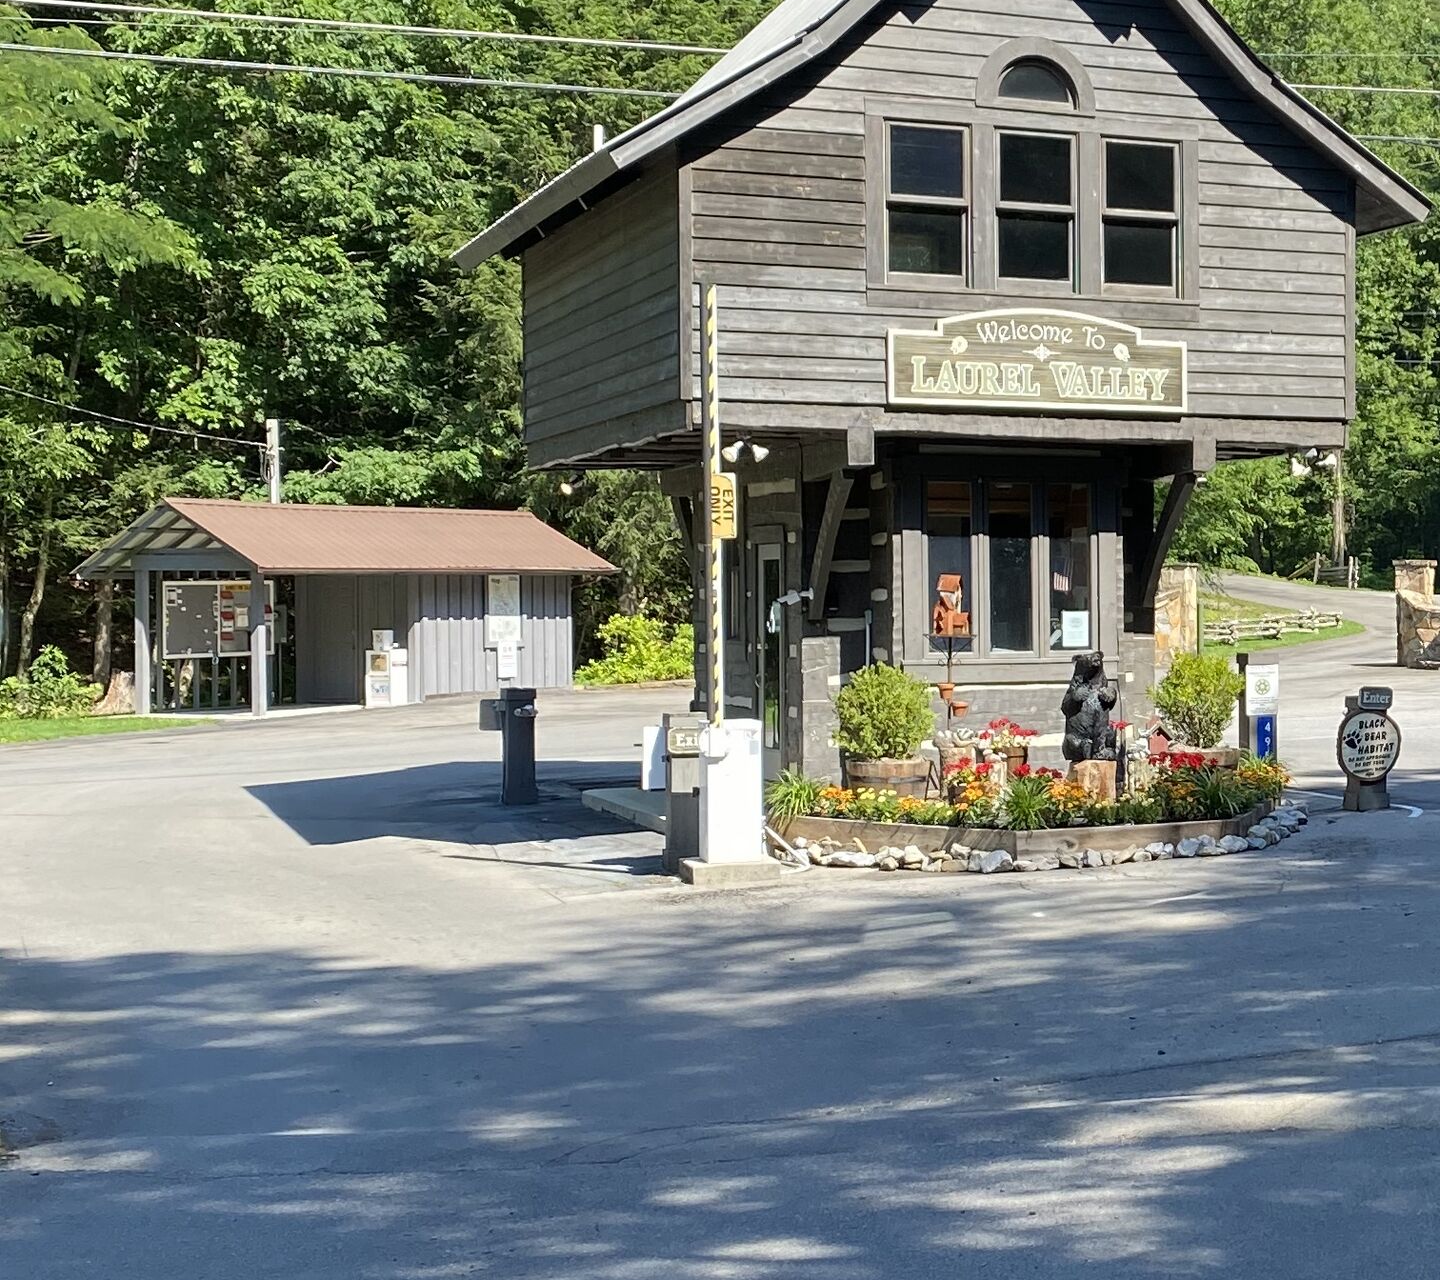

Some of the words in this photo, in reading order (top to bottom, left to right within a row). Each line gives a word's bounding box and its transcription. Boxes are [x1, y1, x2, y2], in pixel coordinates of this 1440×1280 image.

[976, 319, 1073, 344] Welcome
[1082, 326, 1105, 349] To
[911, 355, 1040, 397] LAUREL
[1049, 361, 1169, 400] VALLEY
[710, 486, 721, 526] ONLY
[722, 489, 734, 523] EXIT
[1362, 691, 1391, 704] Enter
[1358, 719, 1387, 730] BLACK
[675, 733, 699, 747] Exi
[1364, 731, 1387, 741] BEAR
[1357, 742, 1395, 755] HABITAT
